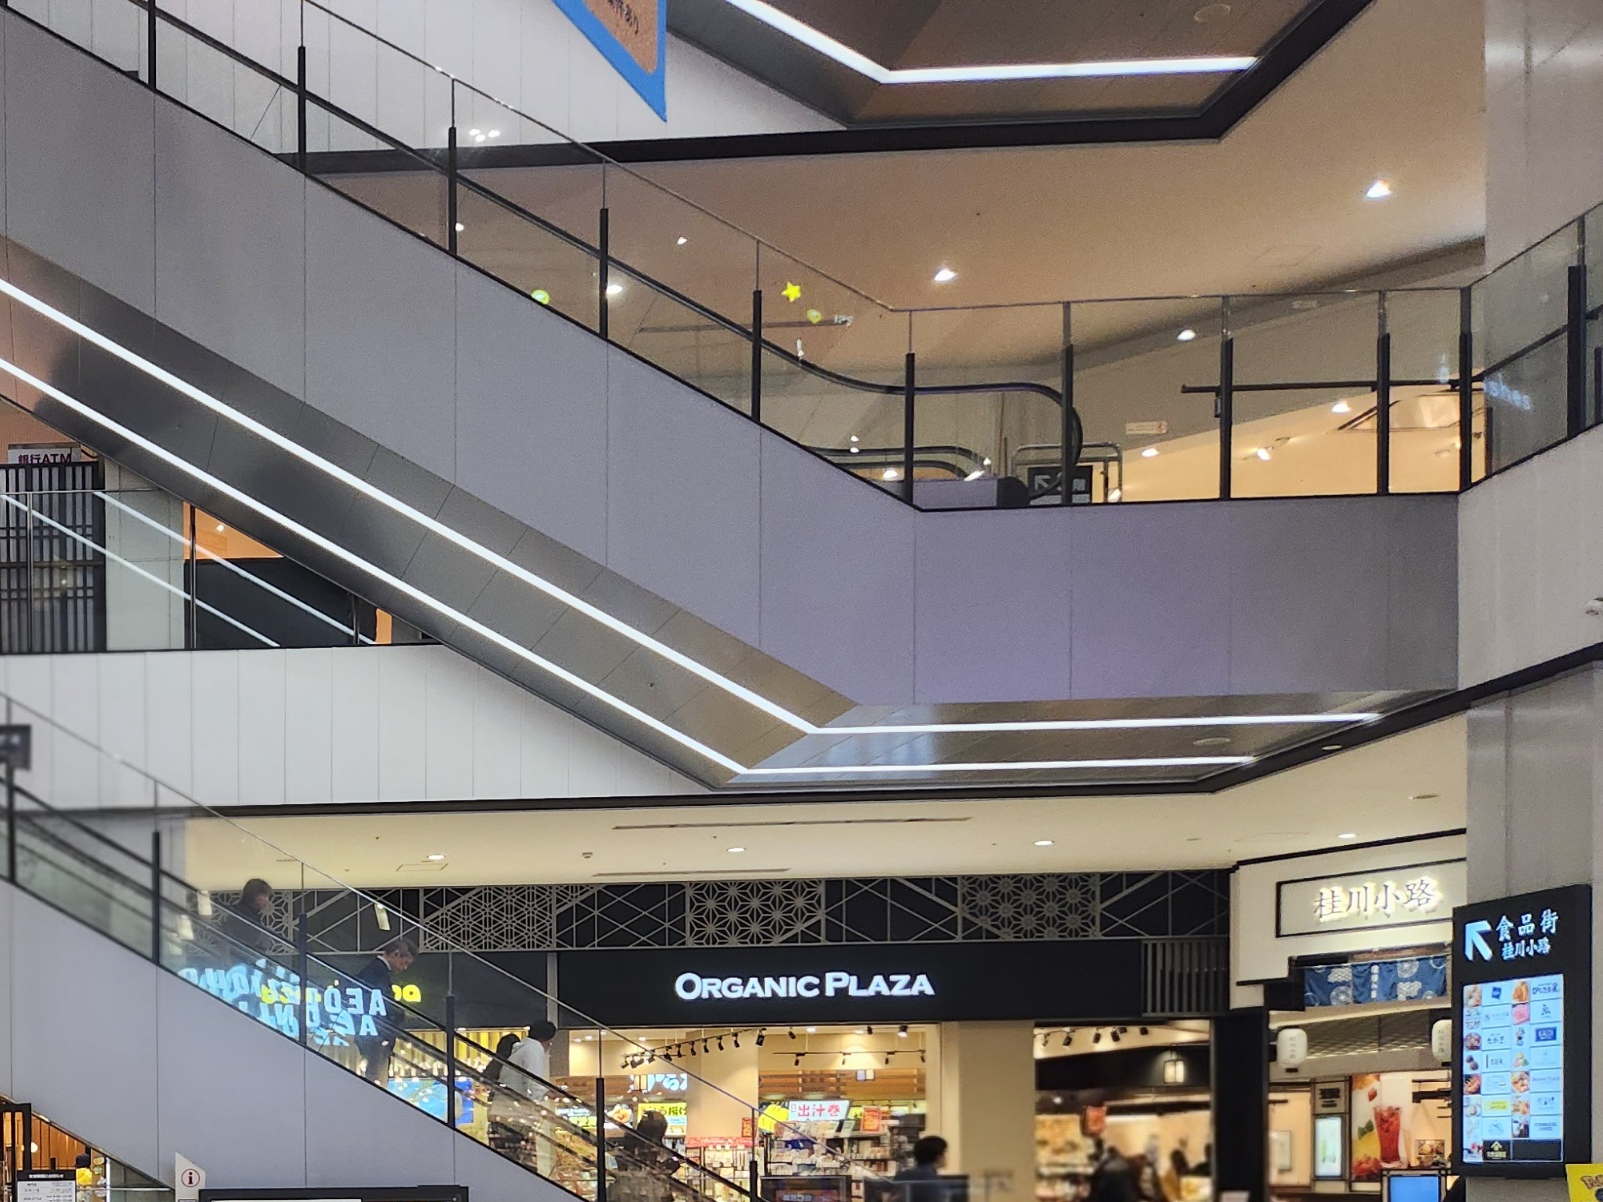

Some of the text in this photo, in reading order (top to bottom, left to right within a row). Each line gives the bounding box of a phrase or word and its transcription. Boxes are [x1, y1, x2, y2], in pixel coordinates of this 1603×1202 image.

[1313, 878, 1435, 919] 桂川小路
[1496, 908, 1559, 942] 食品街
[1502, 937, 1551, 961] 桂川小路
[675, 972, 935, 1000] ORGANIC PLAZA
